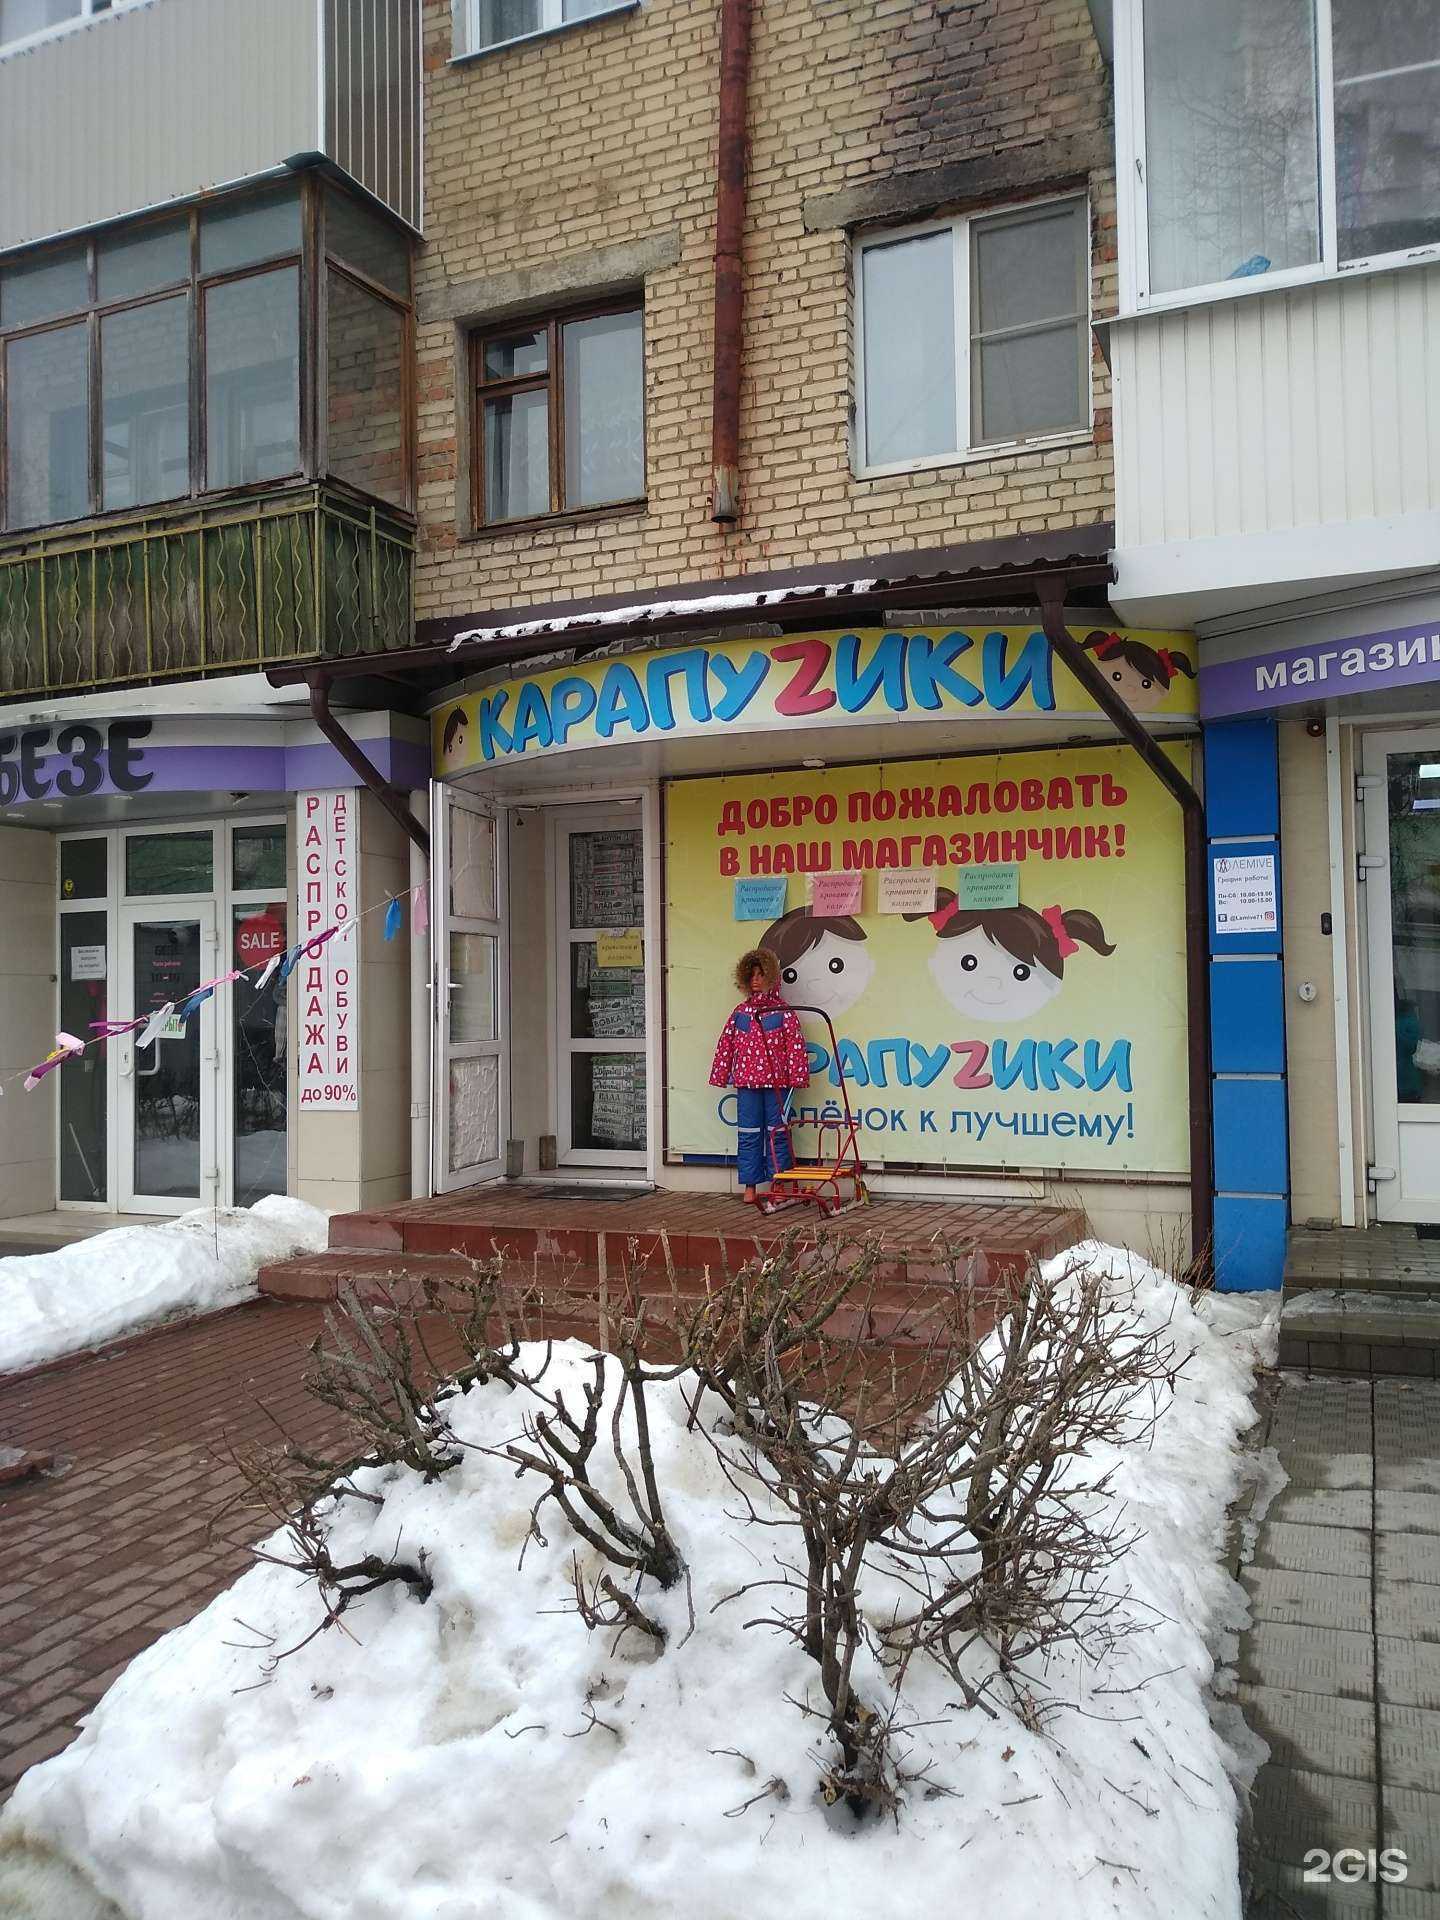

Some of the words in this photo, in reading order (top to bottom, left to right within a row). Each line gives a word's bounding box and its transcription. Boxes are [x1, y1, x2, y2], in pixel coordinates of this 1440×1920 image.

[718, 794, 838, 836] ДОБРО
[847, 774, 1128, 823] ПОЖАЛОВАТЬ
[333, 795, 348, 942] ДЕТСКО
[720, 847, 740, 876] В
[750, 841, 831, 875] НАШ
[842, 824, 1127, 871] МАГАЗИНЧИК!
[240, 931, 280, 950] SALE
[305, 797, 325, 1074] РАСПРОДАЖА
[335, 969, 349, 1074] ОБУВИ
[806, 1037, 1133, 1092] РАПУZИКИ
[301, 1088, 322, 1103] до
[324, 1085, 356, 1101] 90%
[920, 1110, 938, 1132] к
[951, 1102, 1135, 1146] лучшему!
